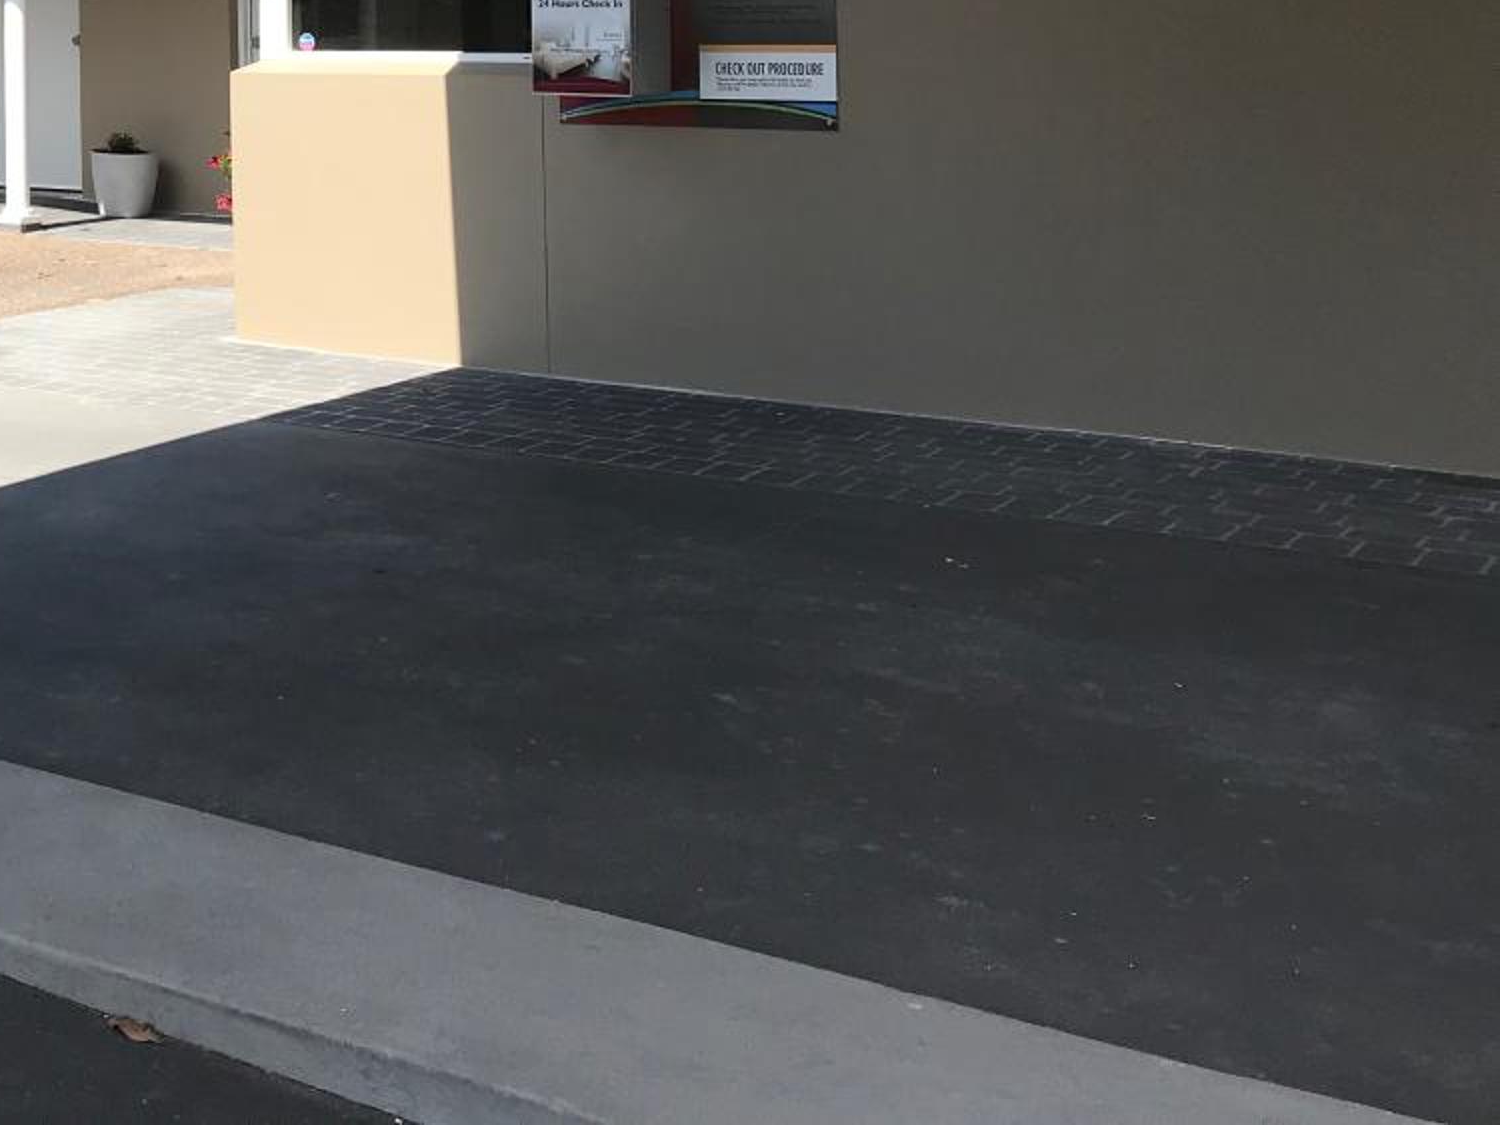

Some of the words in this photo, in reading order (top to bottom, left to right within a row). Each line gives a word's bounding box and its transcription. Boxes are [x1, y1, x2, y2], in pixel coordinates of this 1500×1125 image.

[538, 0, 549, 8] 24
[715, 61, 745, 76] CHECK
[747, 61, 766, 76] OUT
[767, 61, 825, 76] PROCEDURE
